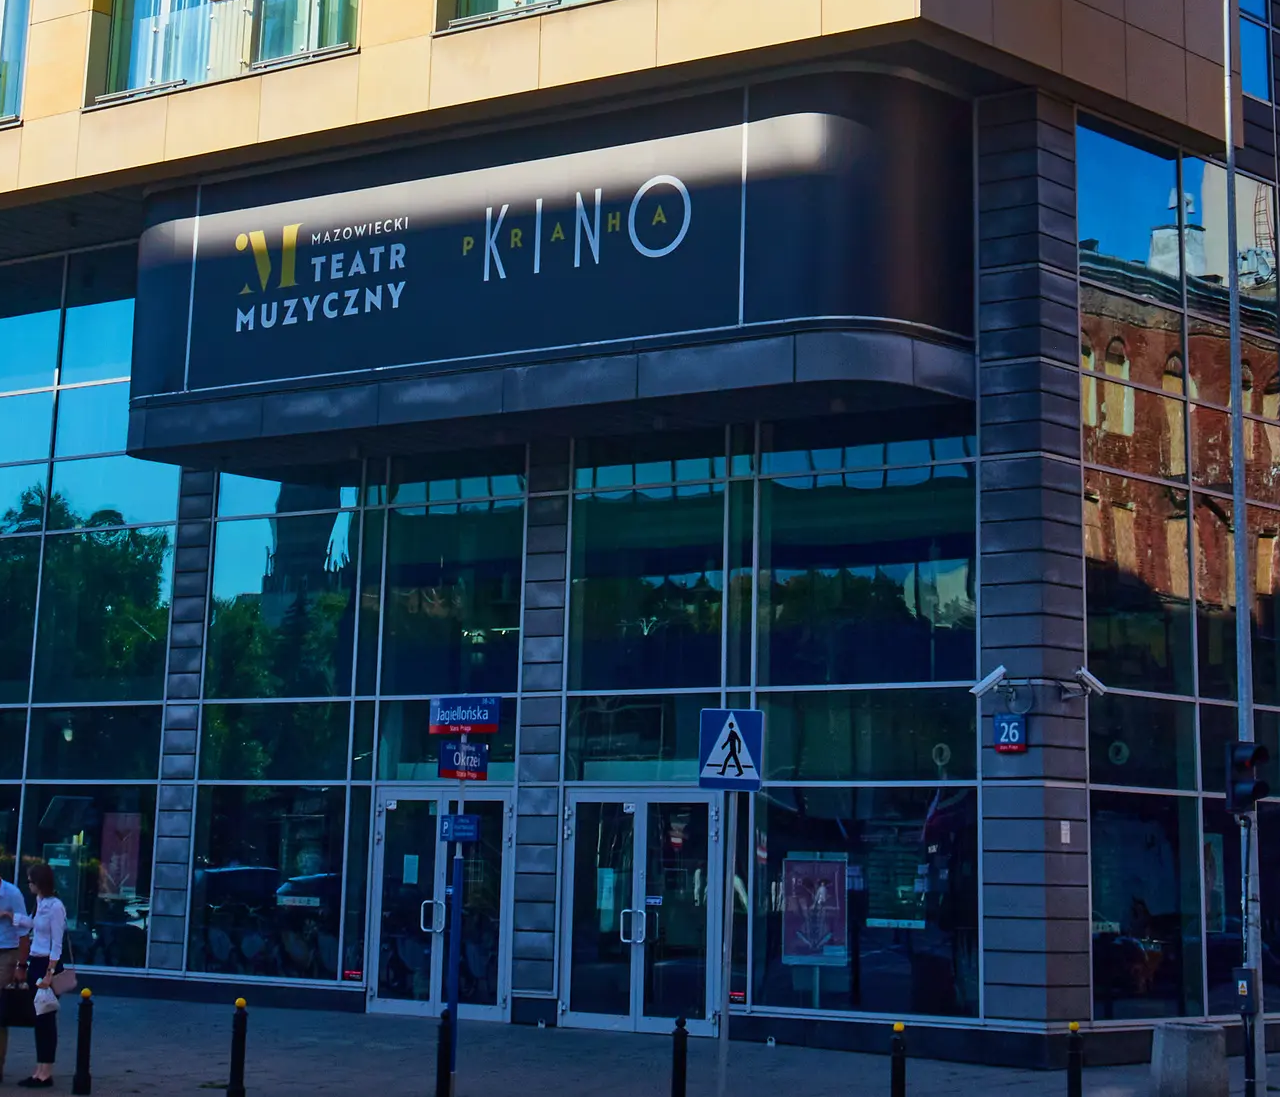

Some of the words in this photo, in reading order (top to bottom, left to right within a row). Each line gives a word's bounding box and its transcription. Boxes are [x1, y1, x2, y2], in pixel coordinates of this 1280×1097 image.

[311, 216, 409, 245] MAZOWIECKI
[483, 174, 692, 281] KINO
[311, 243, 407, 282] TEATR
[235, 281, 406, 333] MUZYCZNY
[437, 705, 489, 725] Jagiellońska
[1000, 722, 1020, 742] 26
[453, 751, 481, 768] Okrzei
